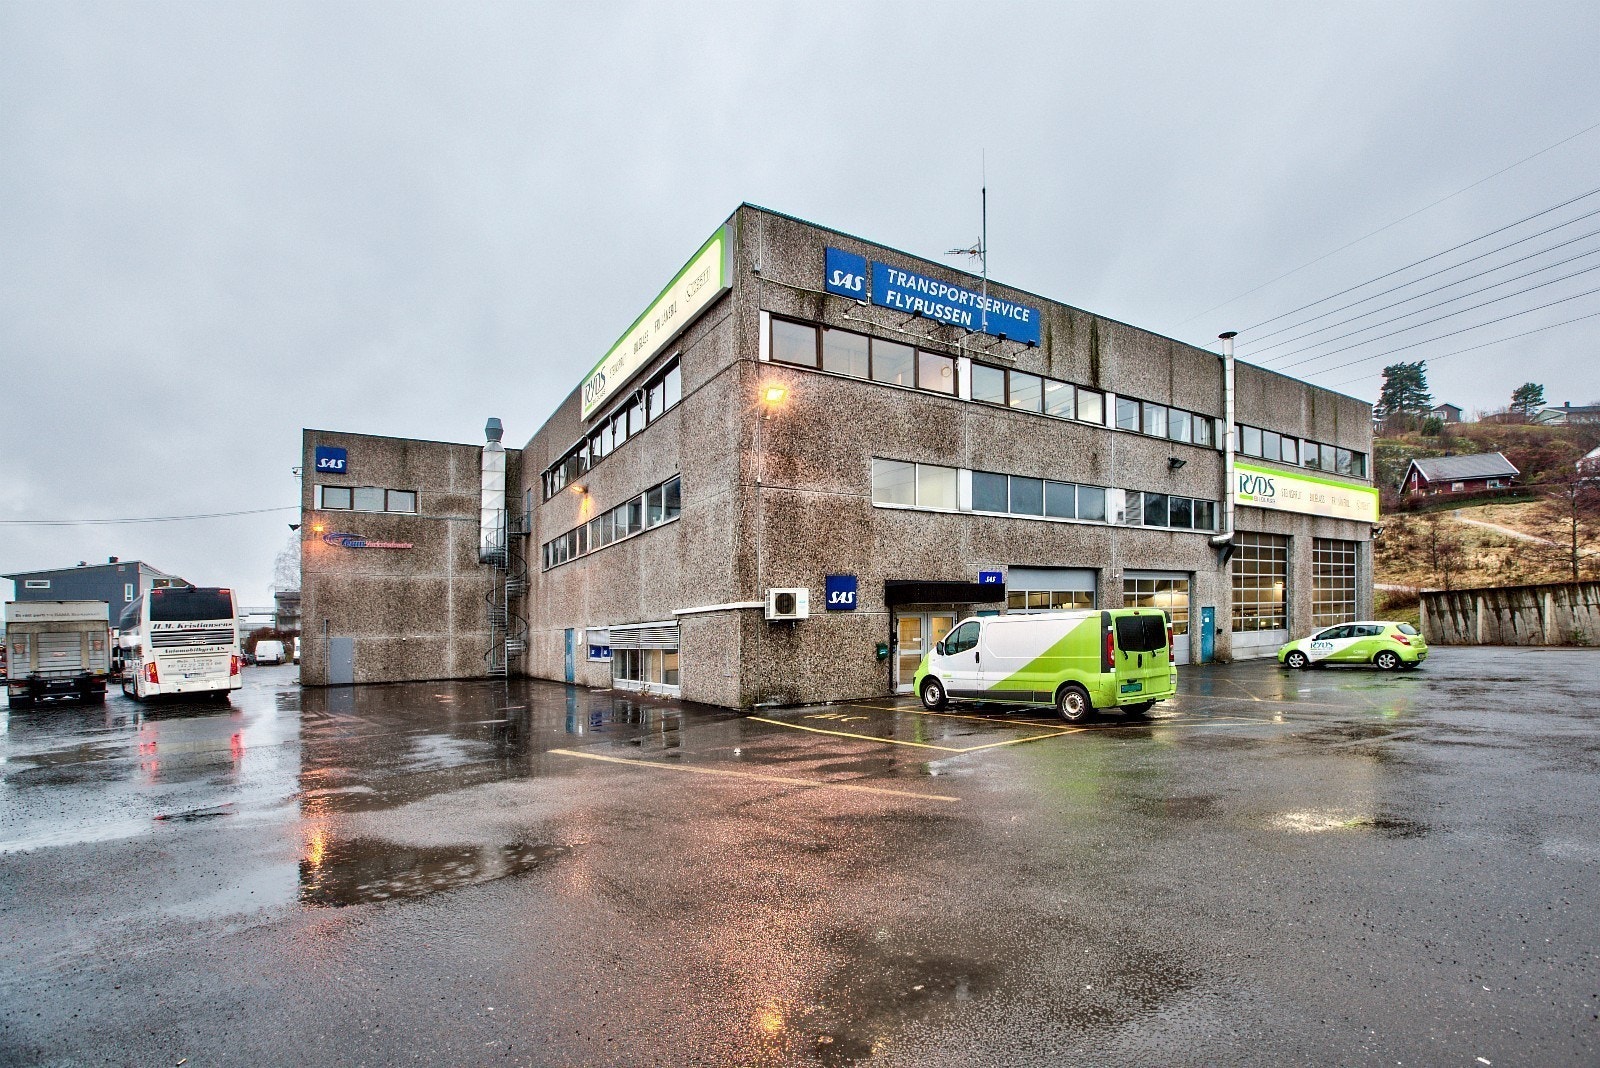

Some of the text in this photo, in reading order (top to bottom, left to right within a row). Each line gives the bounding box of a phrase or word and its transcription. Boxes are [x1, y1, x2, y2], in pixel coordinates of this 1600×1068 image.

[828, 269, 865, 292] SAS
[887, 268, 1030, 323] TRANSPORTSERVICE
[885, 289, 973, 326] FLYBUSSEN
[584, 365, 606, 406] RYDS
[317, 458, 346, 469] SAS
[1239, 472, 1275, 498] RYDS
[984, 575, 997, 583] SAS
[828, 591, 856, 604] SAS
[1311, 641, 1334, 649] RYDS
